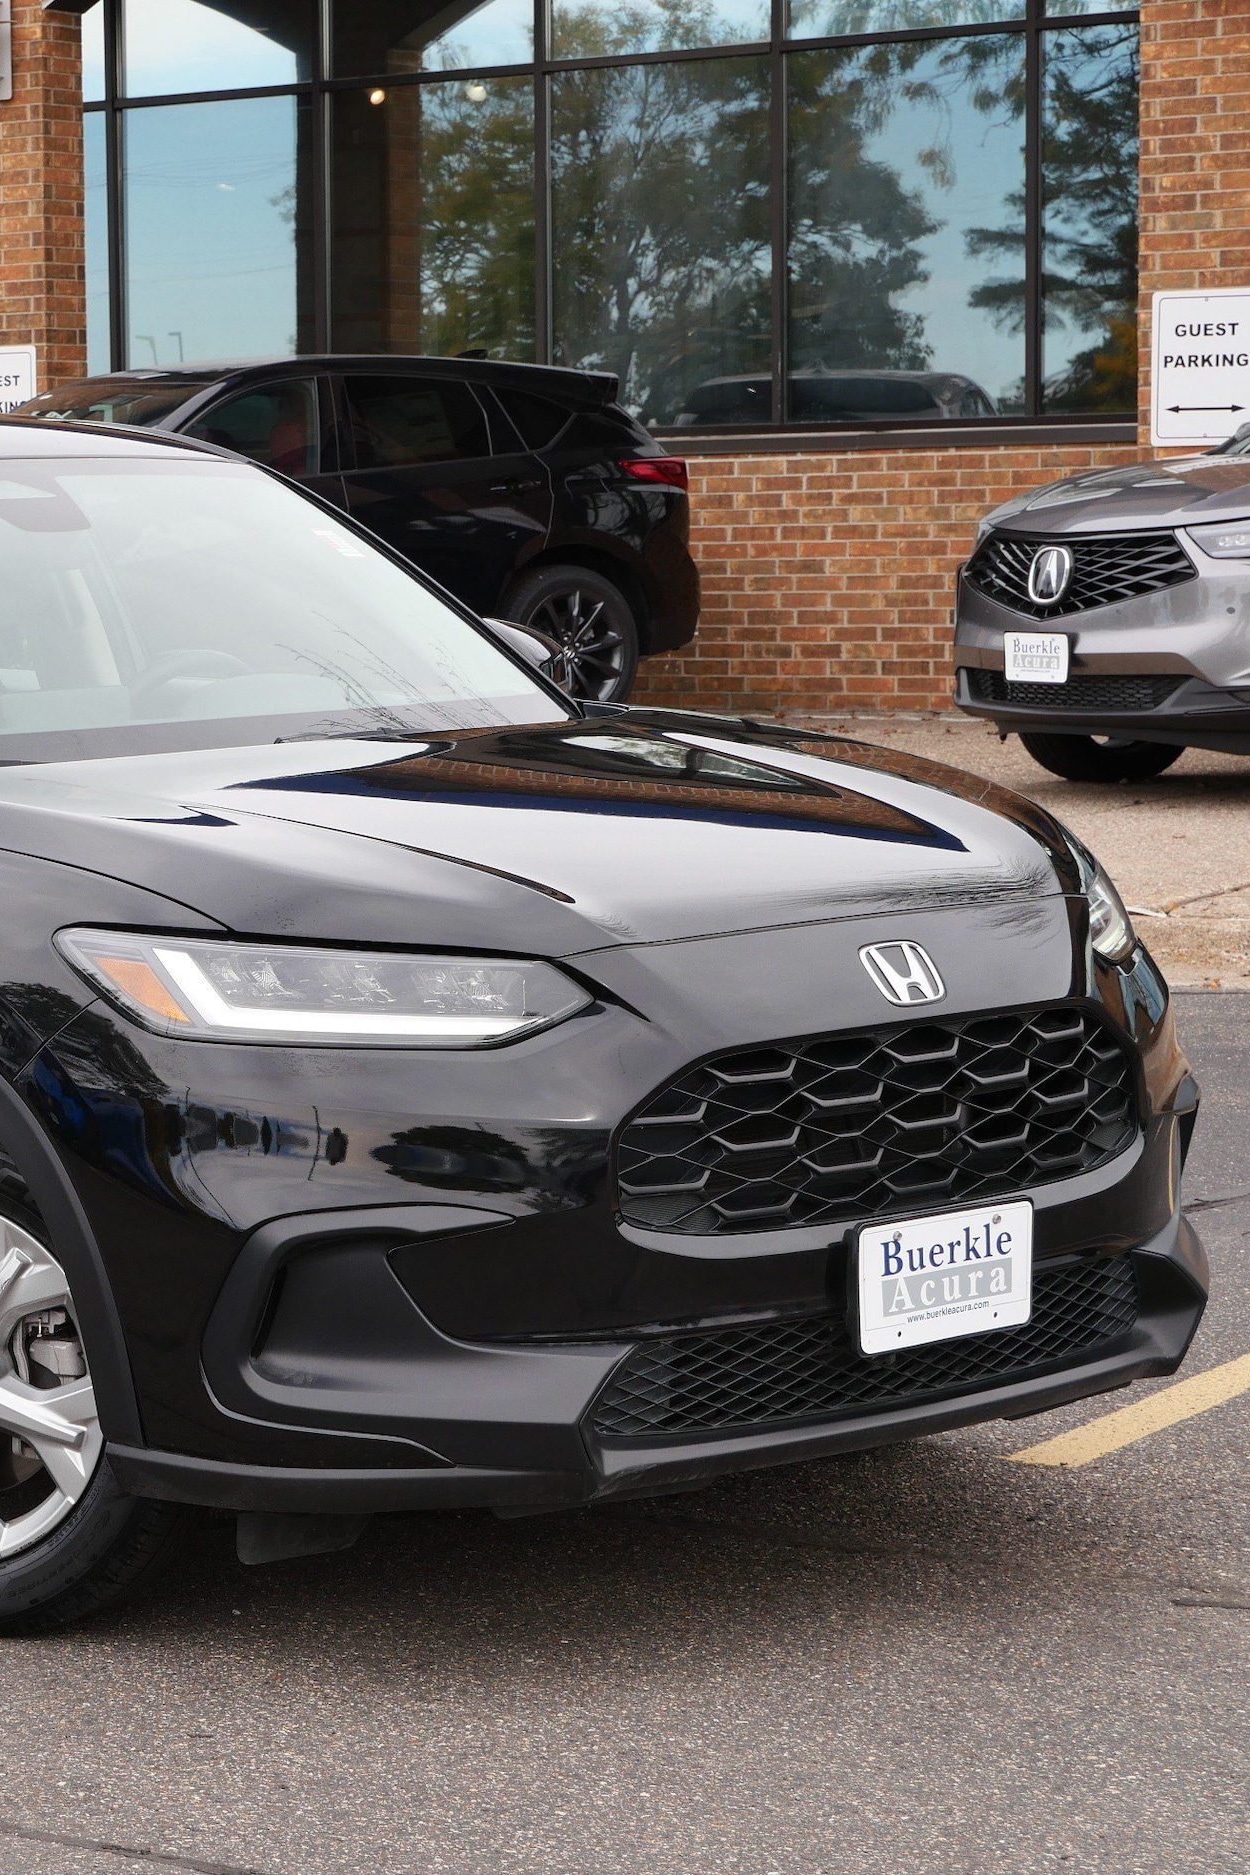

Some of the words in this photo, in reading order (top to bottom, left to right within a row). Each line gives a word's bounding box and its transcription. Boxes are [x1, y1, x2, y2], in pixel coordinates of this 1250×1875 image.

[1175, 323, 1239, 337] GUEST
[1163, 353, 1249, 368] PARKING
[1013, 638, 1060, 655] Buerkle
[1014, 654, 1059, 669] Acura
[881, 1223, 1013, 1277] Buerkle
[888, 1266, 1007, 1313] Acura
[907, 1300, 990, 1324] www.buerkleacura.com
